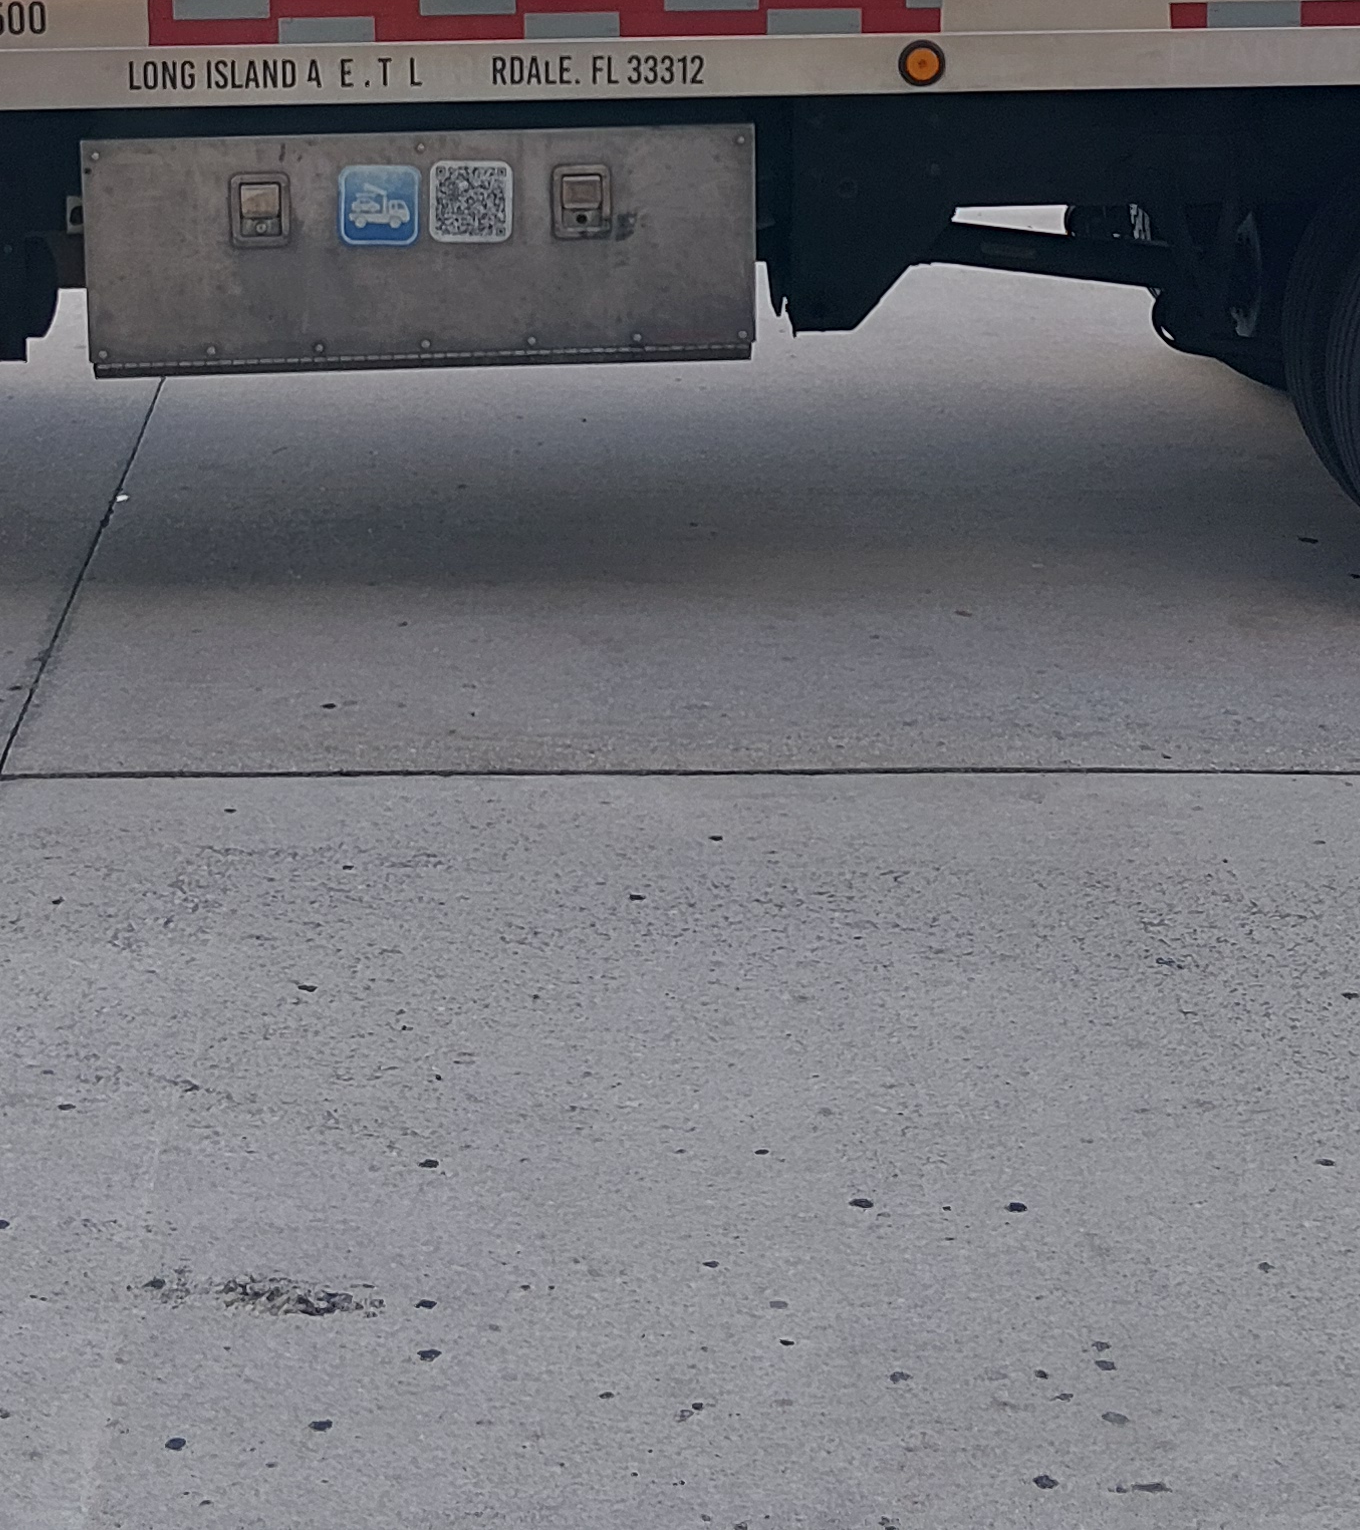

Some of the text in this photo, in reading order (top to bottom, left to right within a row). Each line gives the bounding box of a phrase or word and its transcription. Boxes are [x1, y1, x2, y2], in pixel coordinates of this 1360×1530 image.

[129, 60, 196, 90] LONG
[206, 58, 296, 89] ISLAND
[591, 55, 619, 85] FL
[627, 54, 705, 85] 33312
